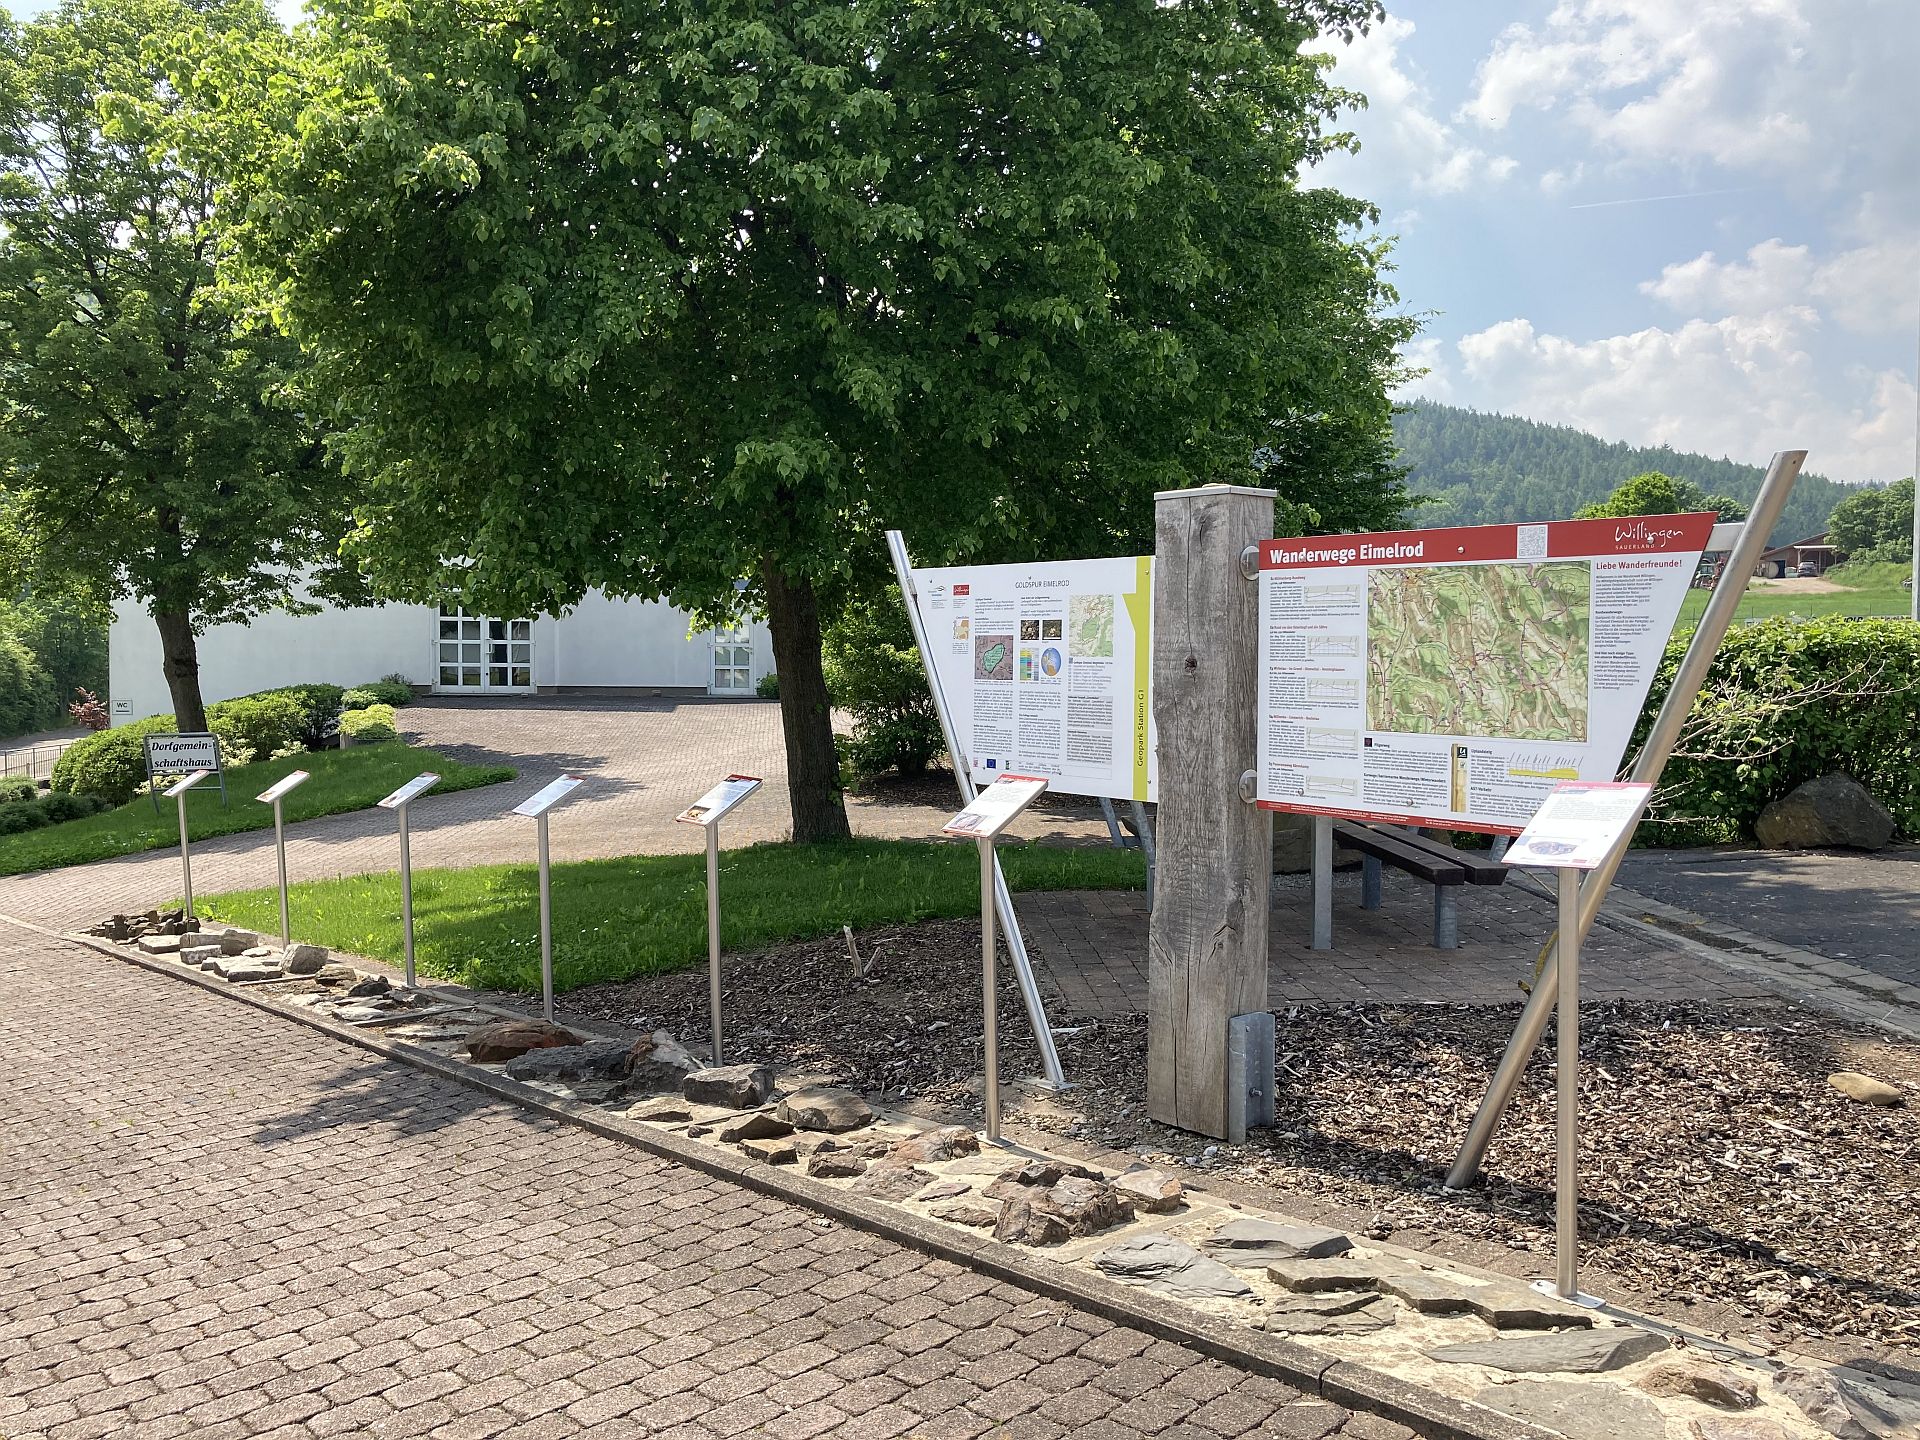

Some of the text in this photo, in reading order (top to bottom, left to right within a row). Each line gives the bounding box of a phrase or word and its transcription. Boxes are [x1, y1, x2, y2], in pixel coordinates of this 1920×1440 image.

[1614, 521, 1684, 548] Willingen
[1269, 540, 1424, 565] Wanderwege Eimelrod
[1596, 559, 1682, 570] Liebe Wanderfreunde!
[1015, 579, 1070, 589] GOLDSPUR EIMELROD
[152, 741, 213, 753] Dorfgemein-
[1136, 732, 1145, 767] Geopark
[154, 758, 212, 768] schaftshaus
